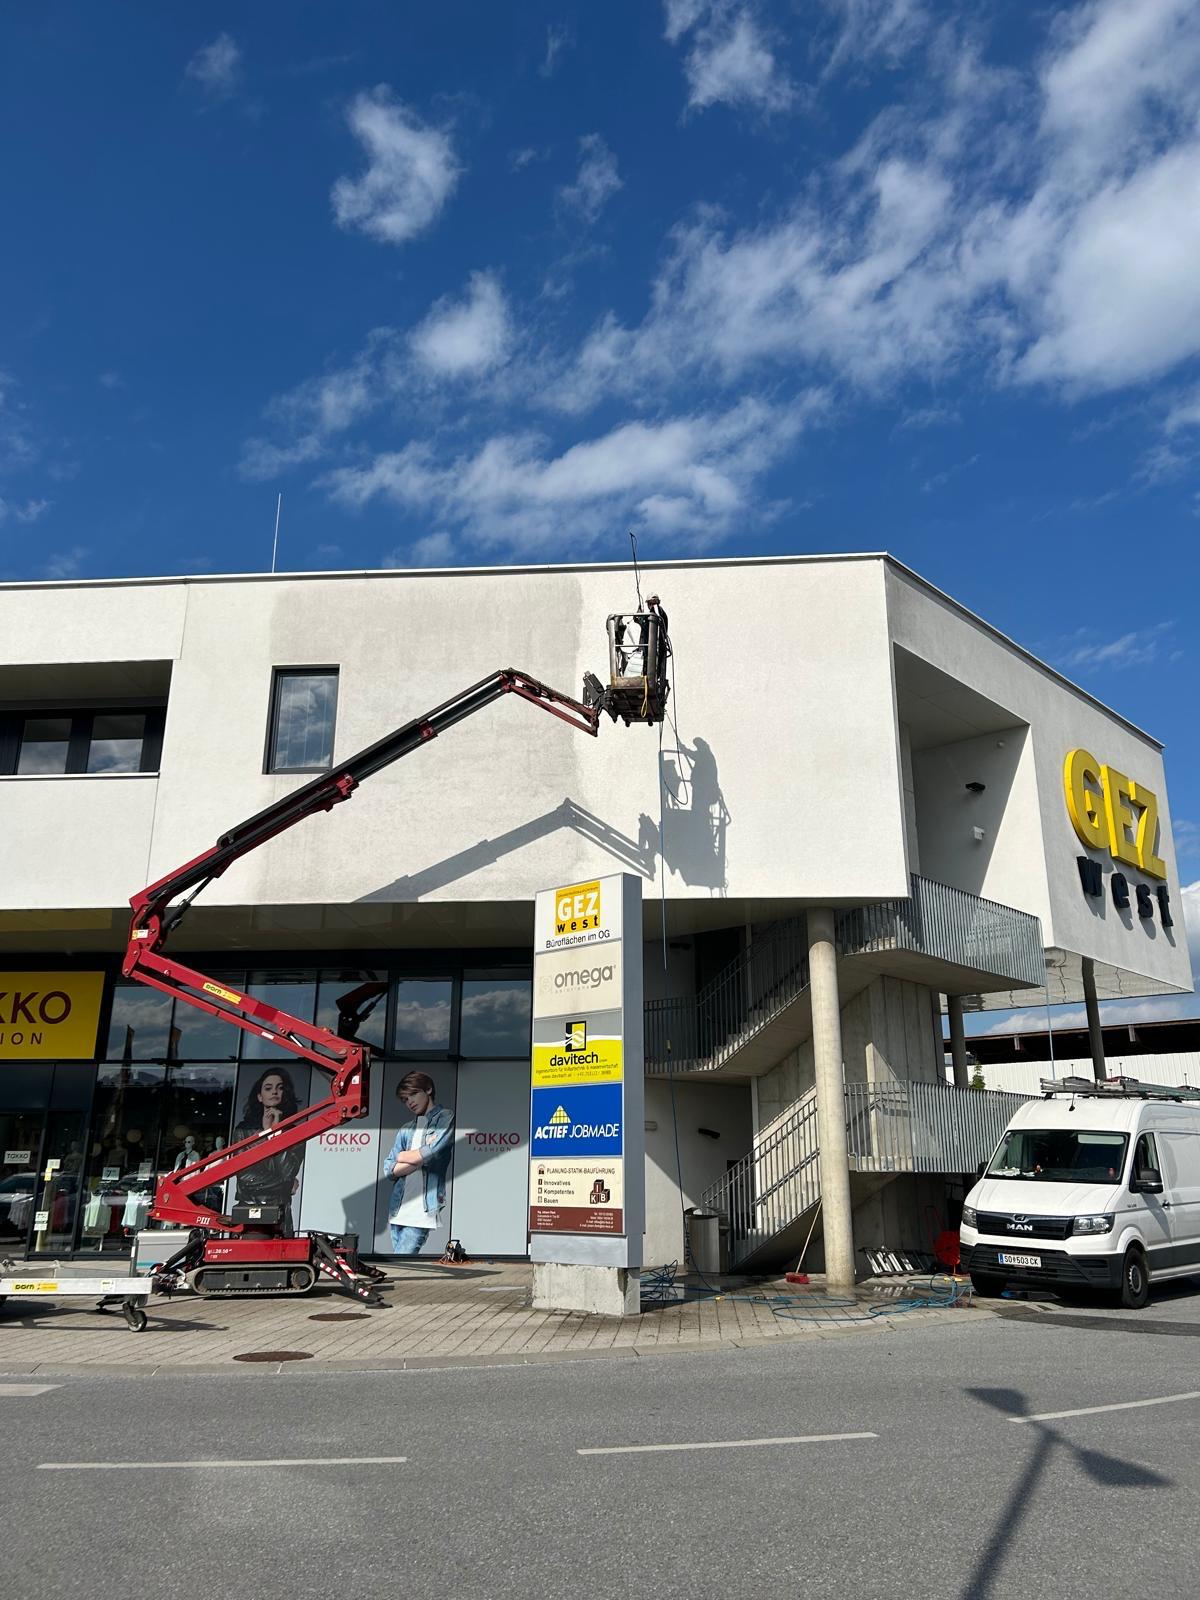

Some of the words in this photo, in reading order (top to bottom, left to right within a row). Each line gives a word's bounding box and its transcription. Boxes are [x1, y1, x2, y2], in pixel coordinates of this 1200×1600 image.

[1064, 749, 1167, 880] GEZ
[1077, 856, 1174, 927] west
[558, 892, 598, 922] GEZ
[557, 915, 599, 933] west
[546, 935, 586, 948] Büroflächen
[587, 933, 597, 941] im
[598, 930, 610, 939] OG
[554, 965, 613, 988] omega
[549, 1051, 599, 1066] davitech
[534, 1125, 568, 1139] ACTIEF
[569, 1124, 620, 1138] JOBMADE
[601, 1193, 606, 1202] B
[1016, 1256, 1029, 1264] 503
[1030, 1257, 1039, 1265] CK
